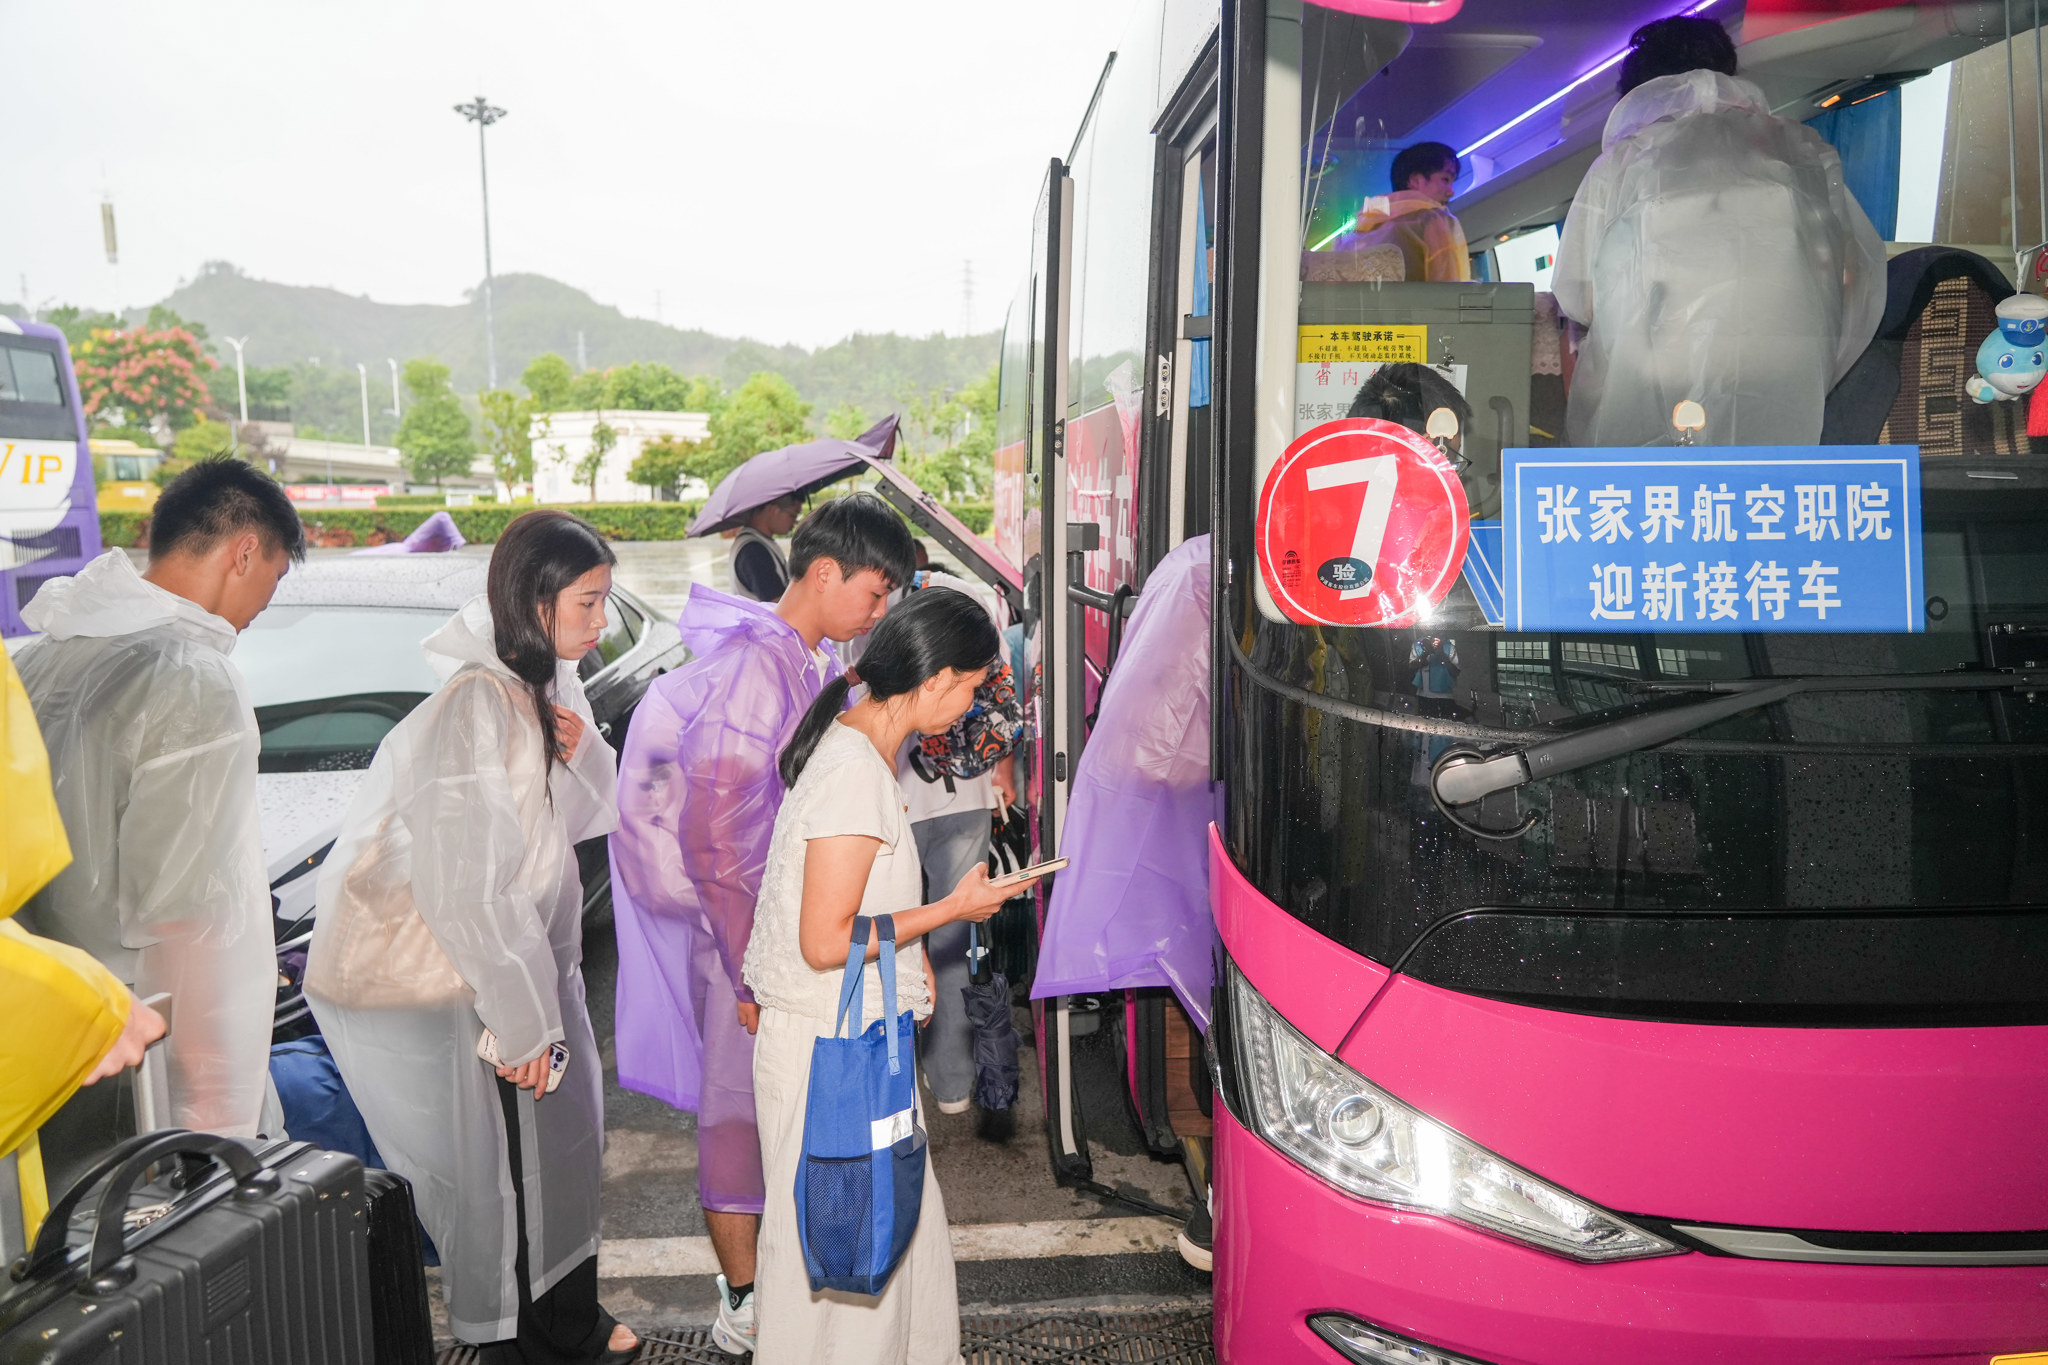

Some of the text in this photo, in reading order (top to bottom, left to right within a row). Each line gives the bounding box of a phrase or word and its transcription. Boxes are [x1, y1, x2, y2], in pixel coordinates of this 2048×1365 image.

[1330, 331, 1393, 342] 本车驾驶承诺
[1305, 454, 1399, 601] 7
[1536, 482, 1893, 544] 张家界航空职院
[1332, 563, 1357, 581] 验
[1588, 560, 1842, 622] 迎新接待车
